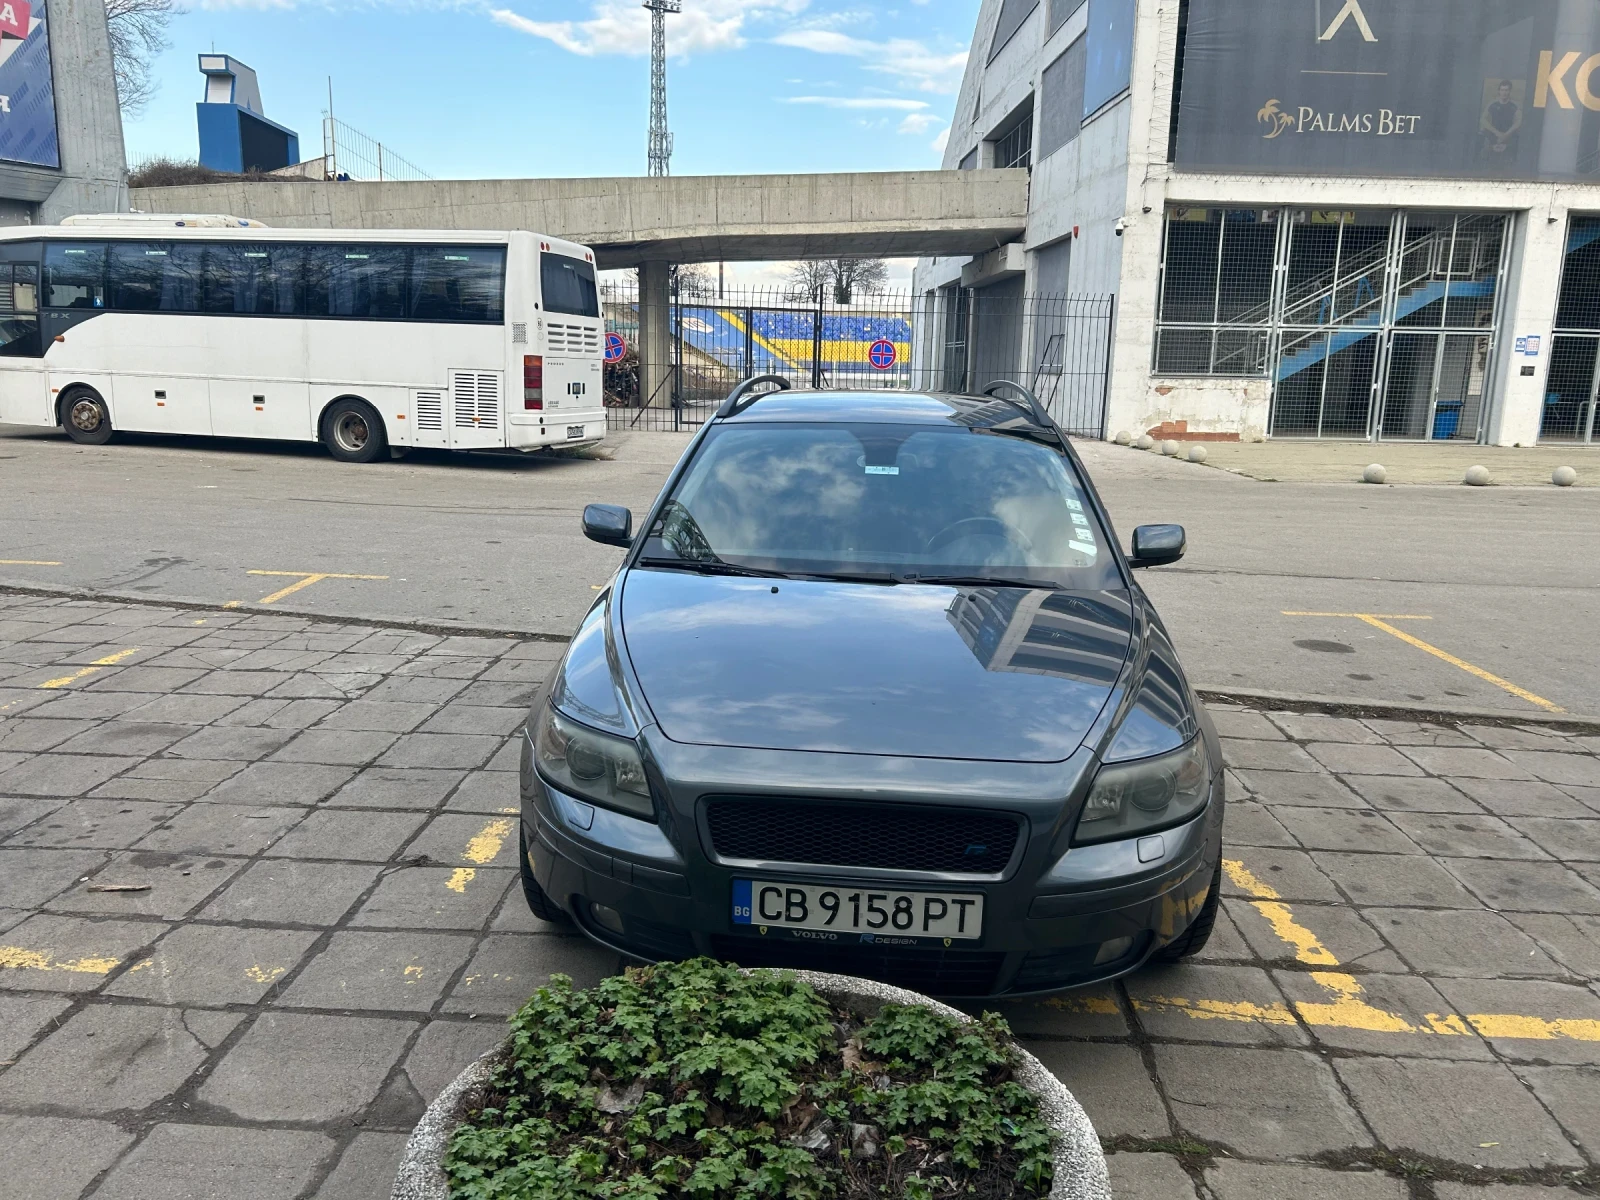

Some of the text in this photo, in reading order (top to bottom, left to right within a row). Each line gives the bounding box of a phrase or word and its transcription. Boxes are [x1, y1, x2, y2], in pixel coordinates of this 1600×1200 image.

[1296, 106, 1421, 135] PALMS BET
[734, 905, 750, 917] BG
[758, 886, 976, 932] CB 9158 PT
[792, 930, 838, 941] VOLVO
